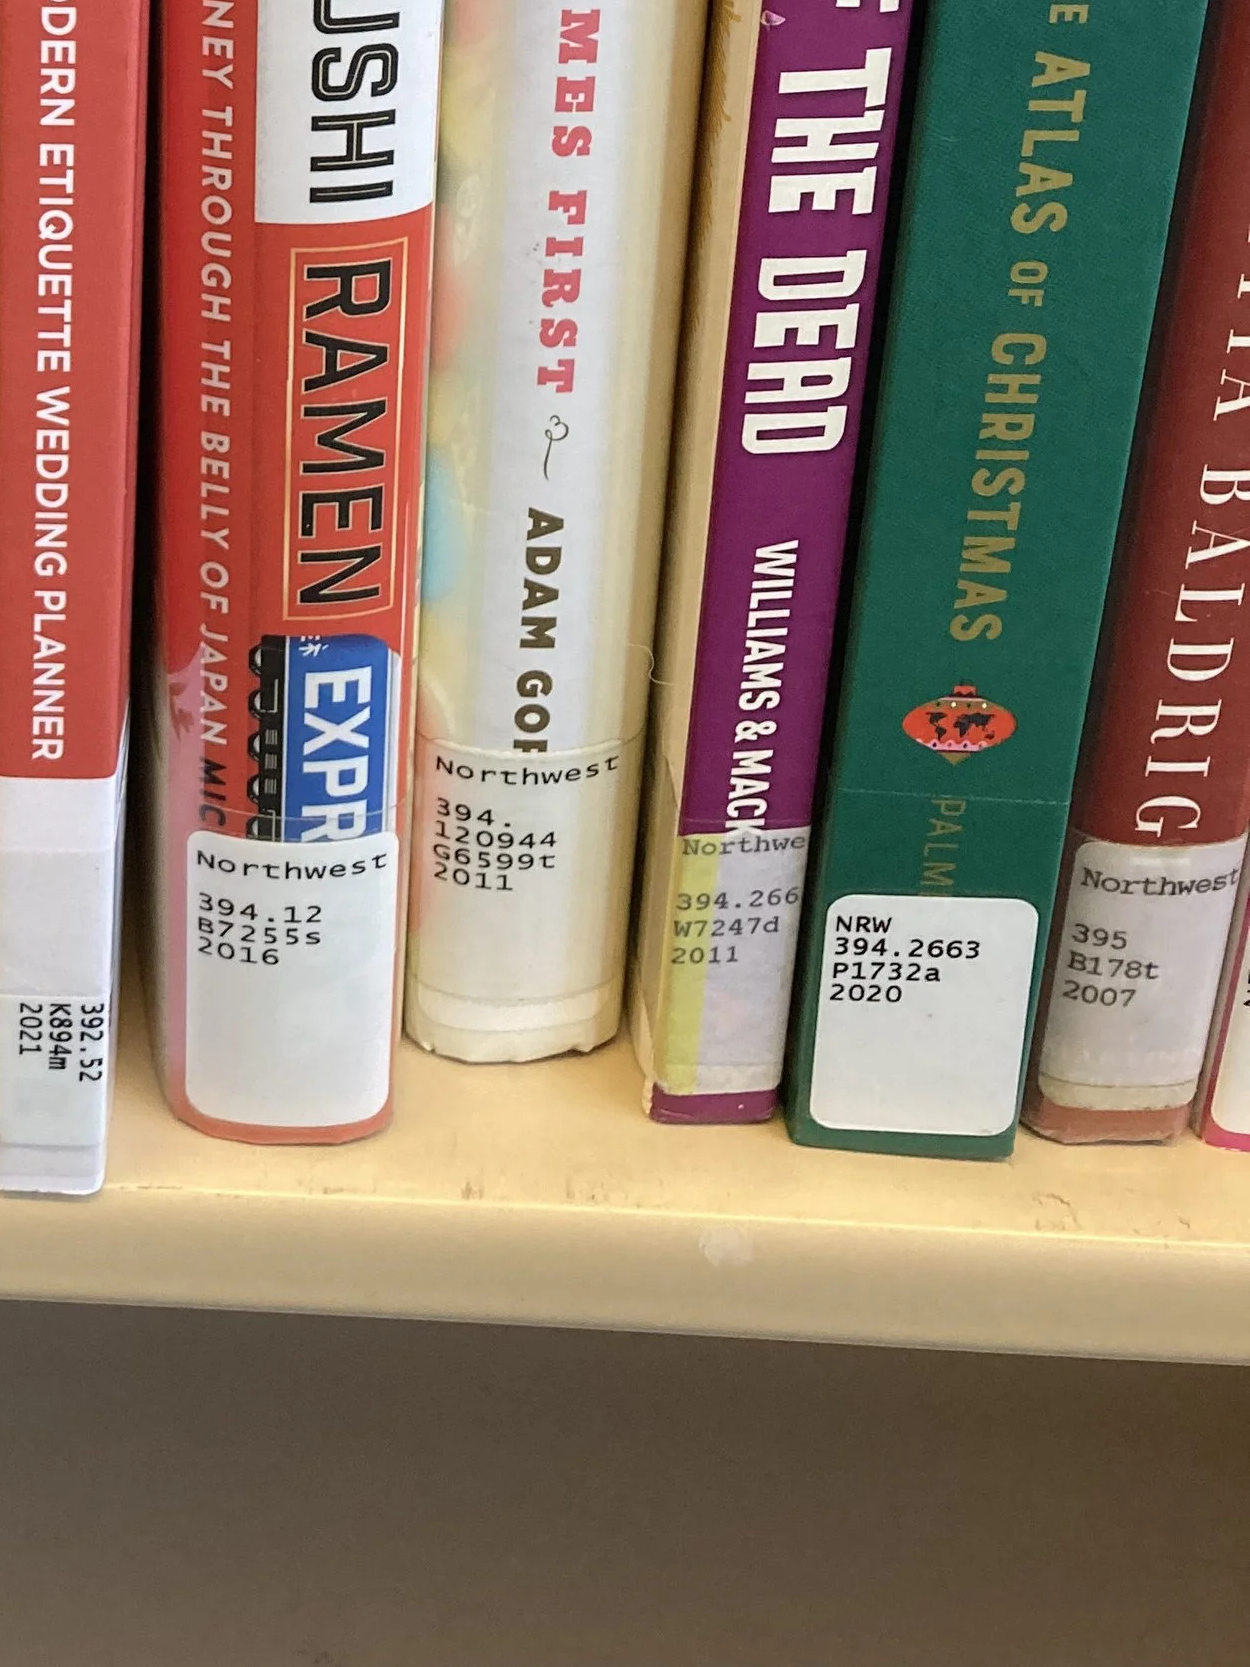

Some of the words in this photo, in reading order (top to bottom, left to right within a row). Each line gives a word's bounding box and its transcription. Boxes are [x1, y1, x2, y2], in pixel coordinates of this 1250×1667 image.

[768, 46, 892, 216] THE
[1010, 51, 1091, 235] ATLAS
[201, 105, 234, 321] THROUGH
[36, 143, 75, 372] ETIQUETTE
[536, 189, 588, 394] FIRST
[1008, 260, 1049, 307] OF
[741, 249, 867, 455] DEAD
[200, 339, 232, 417] THE
[297, 258, 393, 606] RAMEN
[34, 385, 71, 577] WEDDING
[200, 430, 230, 550] BELLY
[950, 332, 1047, 642] CHRISTMAS
[199, 561, 230, 615] OF
[518, 506, 564, 650] ADAM
[738, 539, 799, 711] WILLIAMS
[1135, 464, 1250, 839] BALDRIG
[31, 590, 67, 761] PLANNER
[199, 623, 228, 746] JAPAN
[734, 720, 778, 744] &
[436, 755, 620, 788] Northwest
[435, 819, 558, 849] 120944
[436, 797, 512, 829] 394.
[196, 849, 388, 880] Northwest
[433, 842, 556, 870] G6599t
[918, 799, 967, 898] PALM
[434, 867, 514, 892] 2011
[676, 887, 800, 911] 394.266
[1081, 866, 1241, 897] Northwest
[198, 892, 322, 923] 394.12
[198, 916, 321, 946] B7255s
[673, 915, 780, 938] W7247d
[835, 915, 893, 934] NRW
[197, 936, 280, 966] 2016
[670, 946, 739, 965] 2011
[833, 938, 982, 960] 394.2663
[1071, 922, 1128, 951] 395
[832, 961, 941, 983] P1732a
[1066, 950, 1161, 981] B178t
[829, 983, 903, 1003] 2020
[1061, 979, 1137, 1009] 2007
[18, 1002, 44, 1056] 2021
[48, 1002, 73, 1071] K894m
[78, 1001, 106, 1083] 392.52
